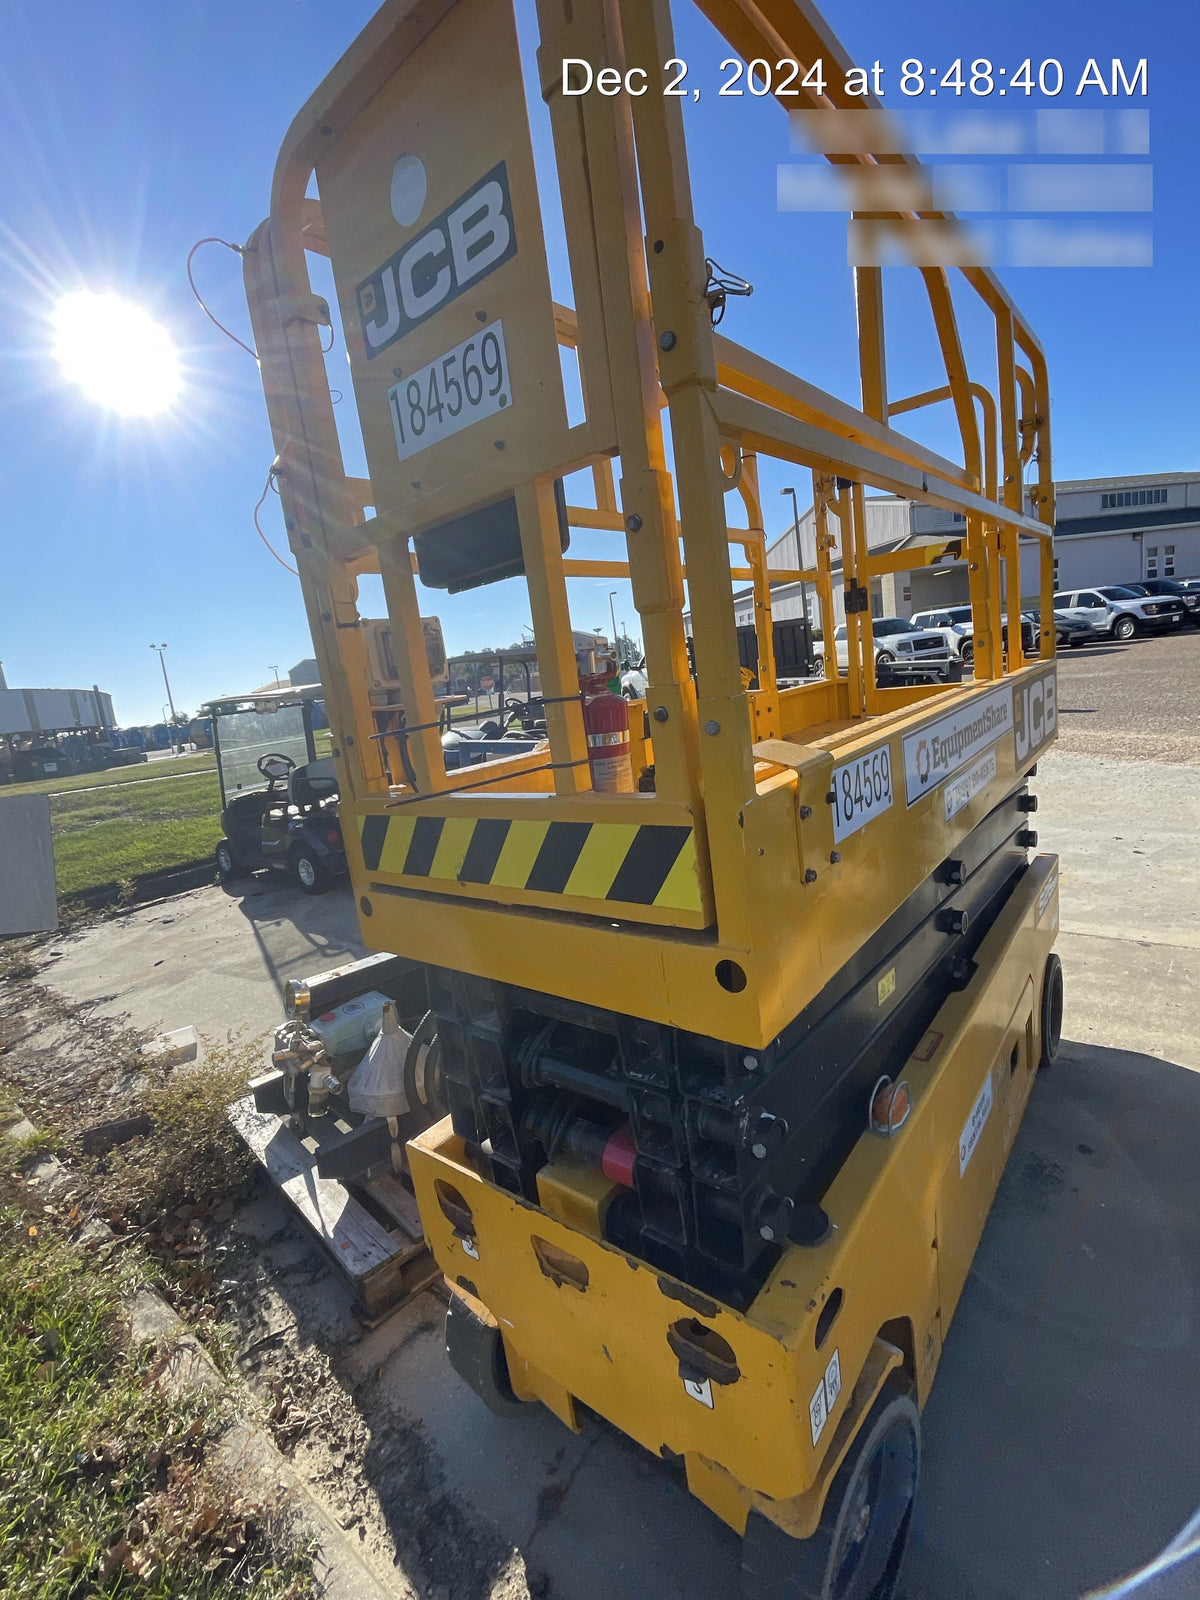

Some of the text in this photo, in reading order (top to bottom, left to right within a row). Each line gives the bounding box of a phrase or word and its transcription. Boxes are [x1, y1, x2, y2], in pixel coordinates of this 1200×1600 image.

[365, 180, 509, 348] JCB
[931, 703, 1008, 769] EquipmentShare
[1015, 674, 1056, 760] JCB
